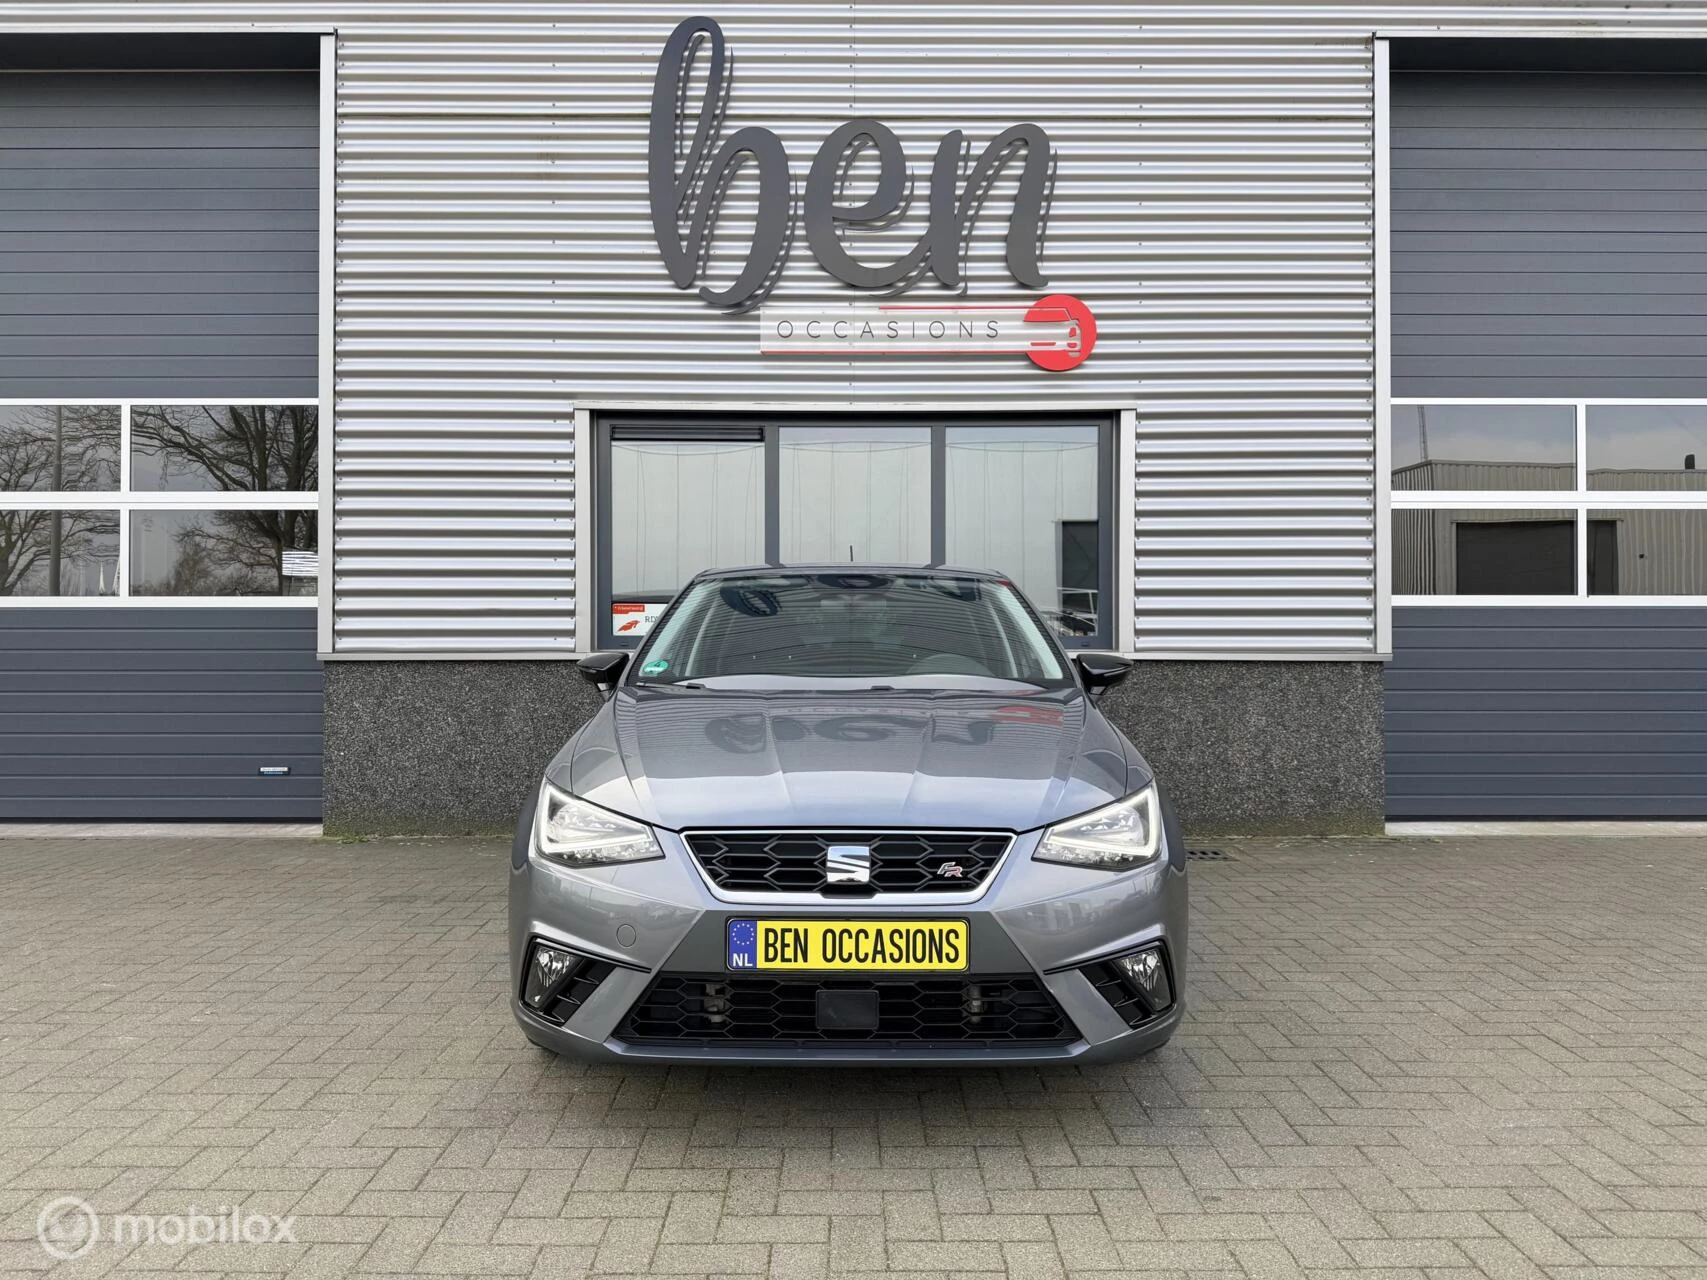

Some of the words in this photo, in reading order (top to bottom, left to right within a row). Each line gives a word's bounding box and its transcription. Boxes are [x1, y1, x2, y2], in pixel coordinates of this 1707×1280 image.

[648, 16, 1056, 307] ben
[776, 319, 999, 340] OCCASIONS
[937, 861, 963, 878] FR
[763, 927, 809, 963] BEN
[822, 928, 960, 964] OCCASIONS
[732, 953, 753, 967] NL
